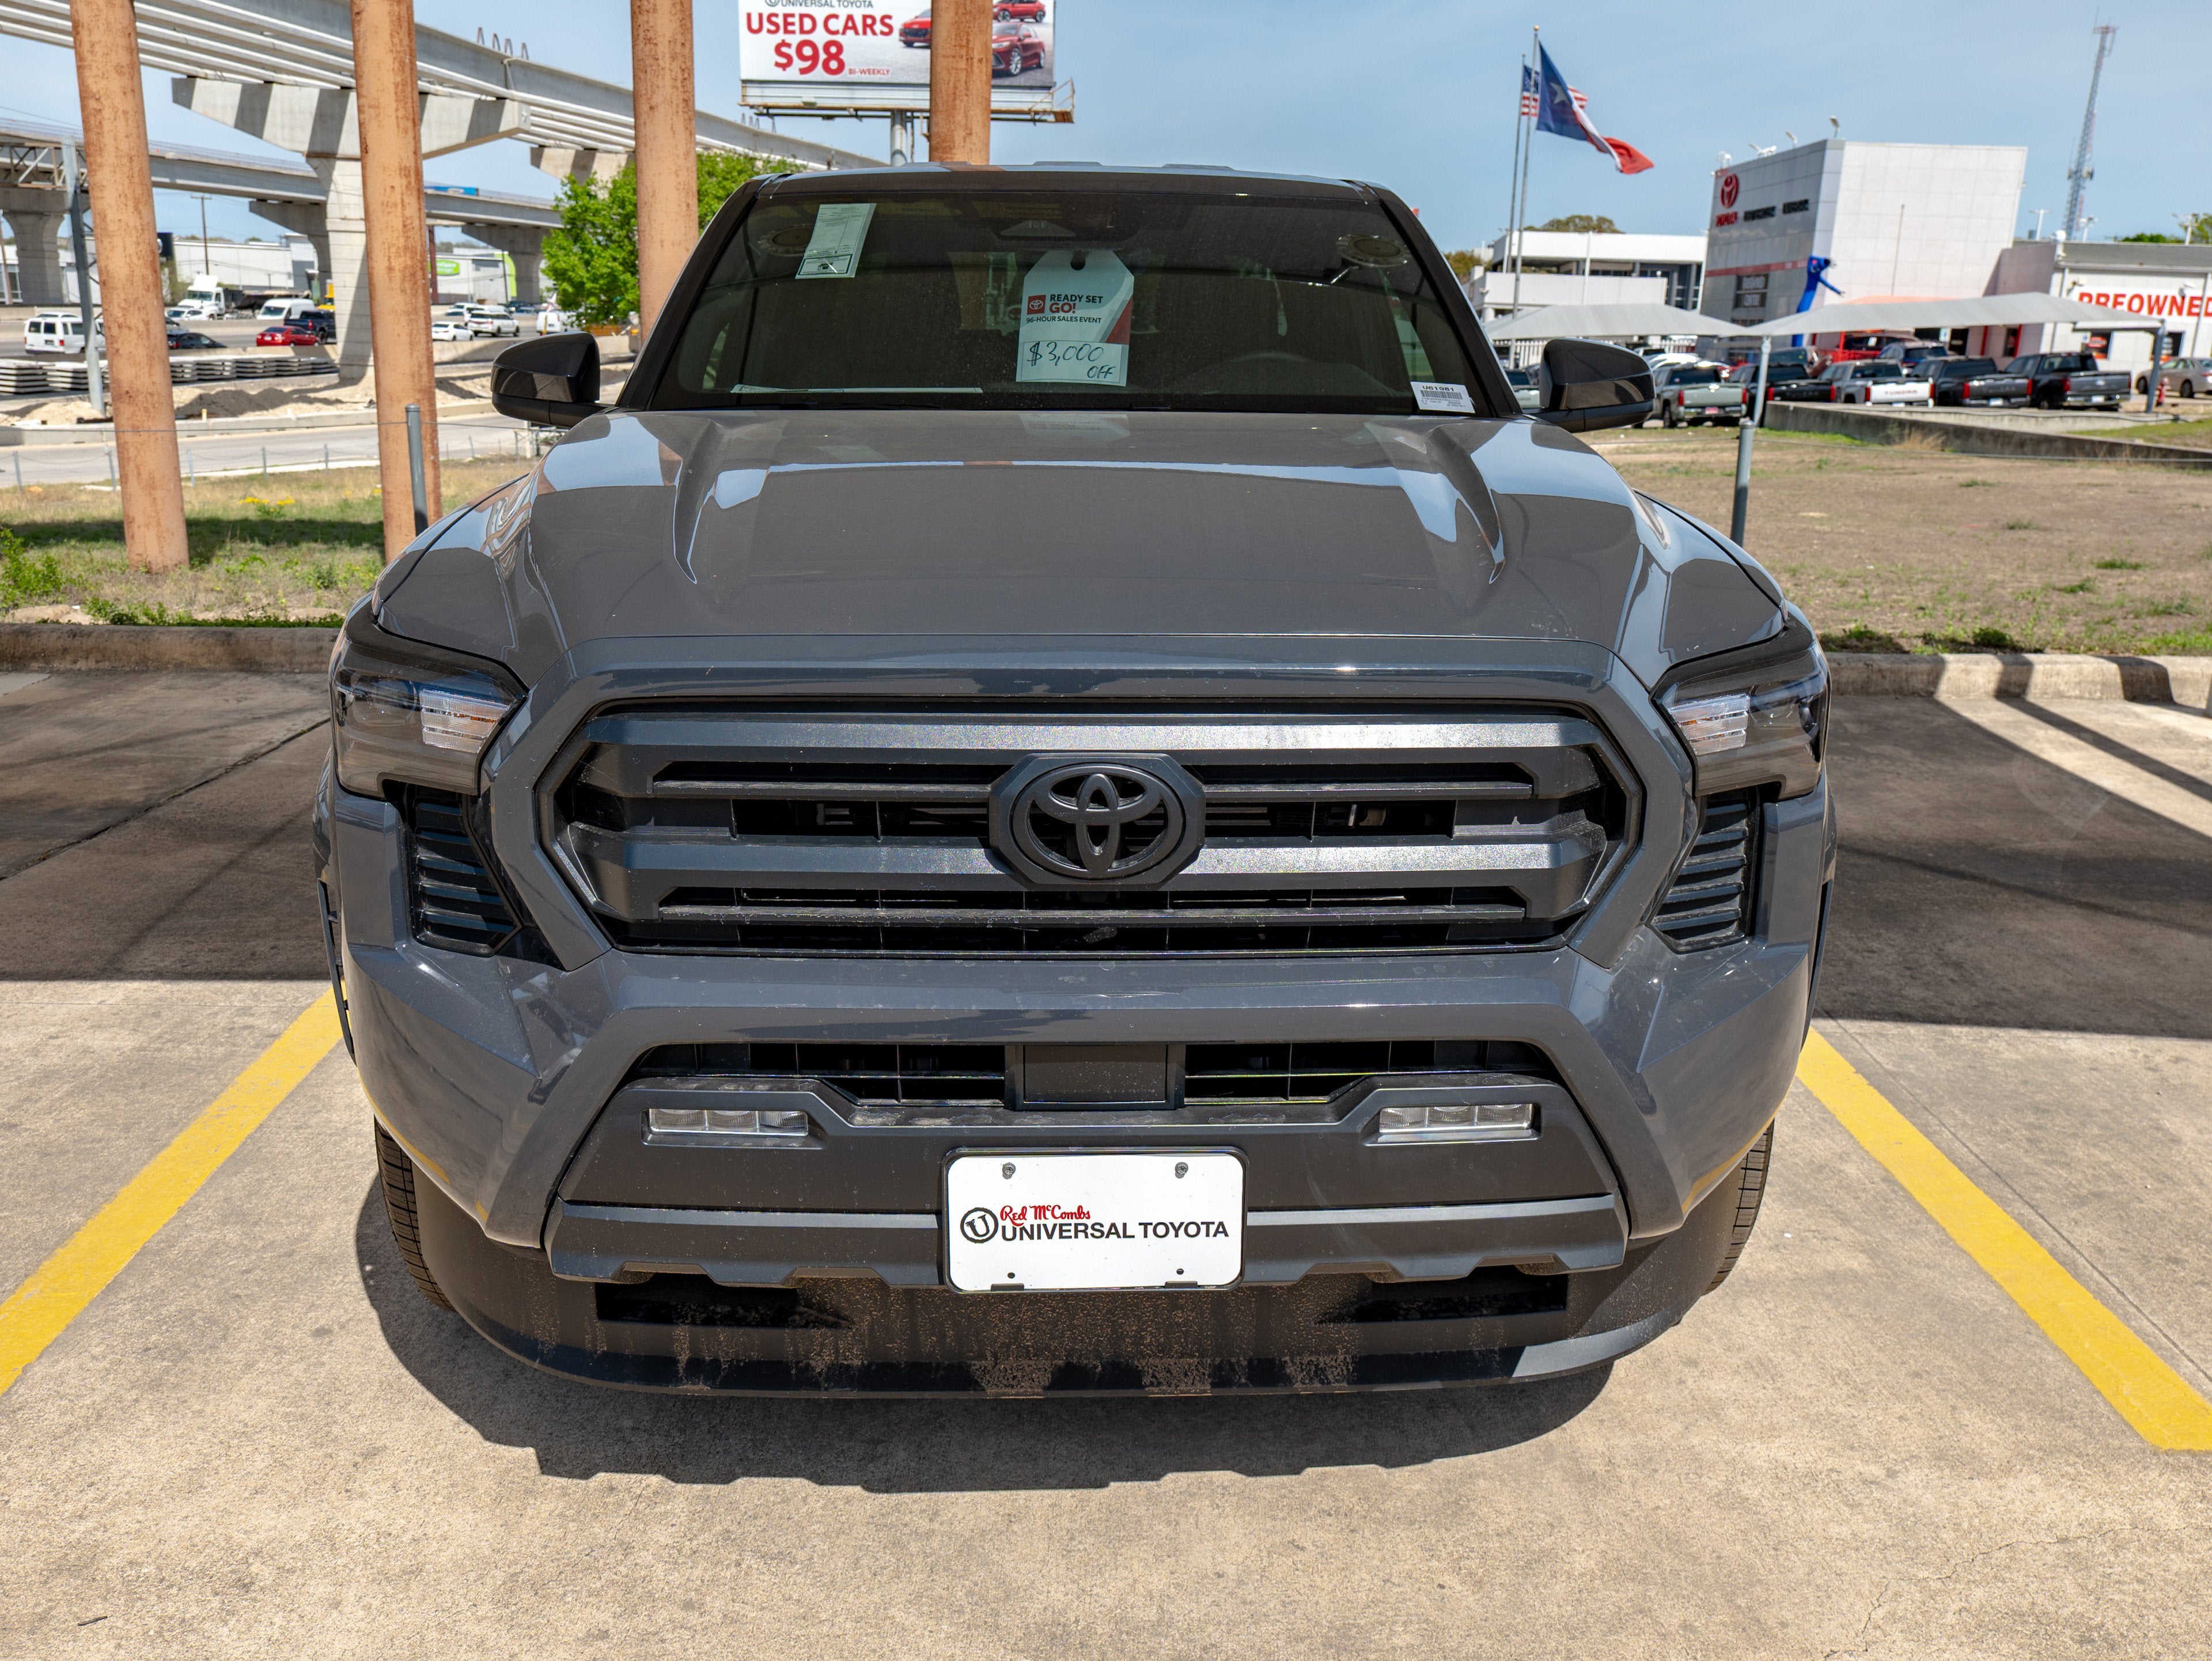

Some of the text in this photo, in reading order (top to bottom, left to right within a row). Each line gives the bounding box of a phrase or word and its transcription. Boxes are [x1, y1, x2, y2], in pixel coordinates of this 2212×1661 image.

[839, 0, 873, 8] TOYOTA
[746, 12, 894, 36] USED CARS
[774, 39, 846, 75] $98
[1049, 302, 1076, 314] GO!
[1050, 294, 1103, 304] READY SET
[1027, 341, 1104, 366] $3,000
[1087, 364, 1116, 379] OFF
[1000, 1205, 1090, 1227] Red McCombs
[1001, 1221, 1229, 1242] UNIVERSAL TOYOTA
